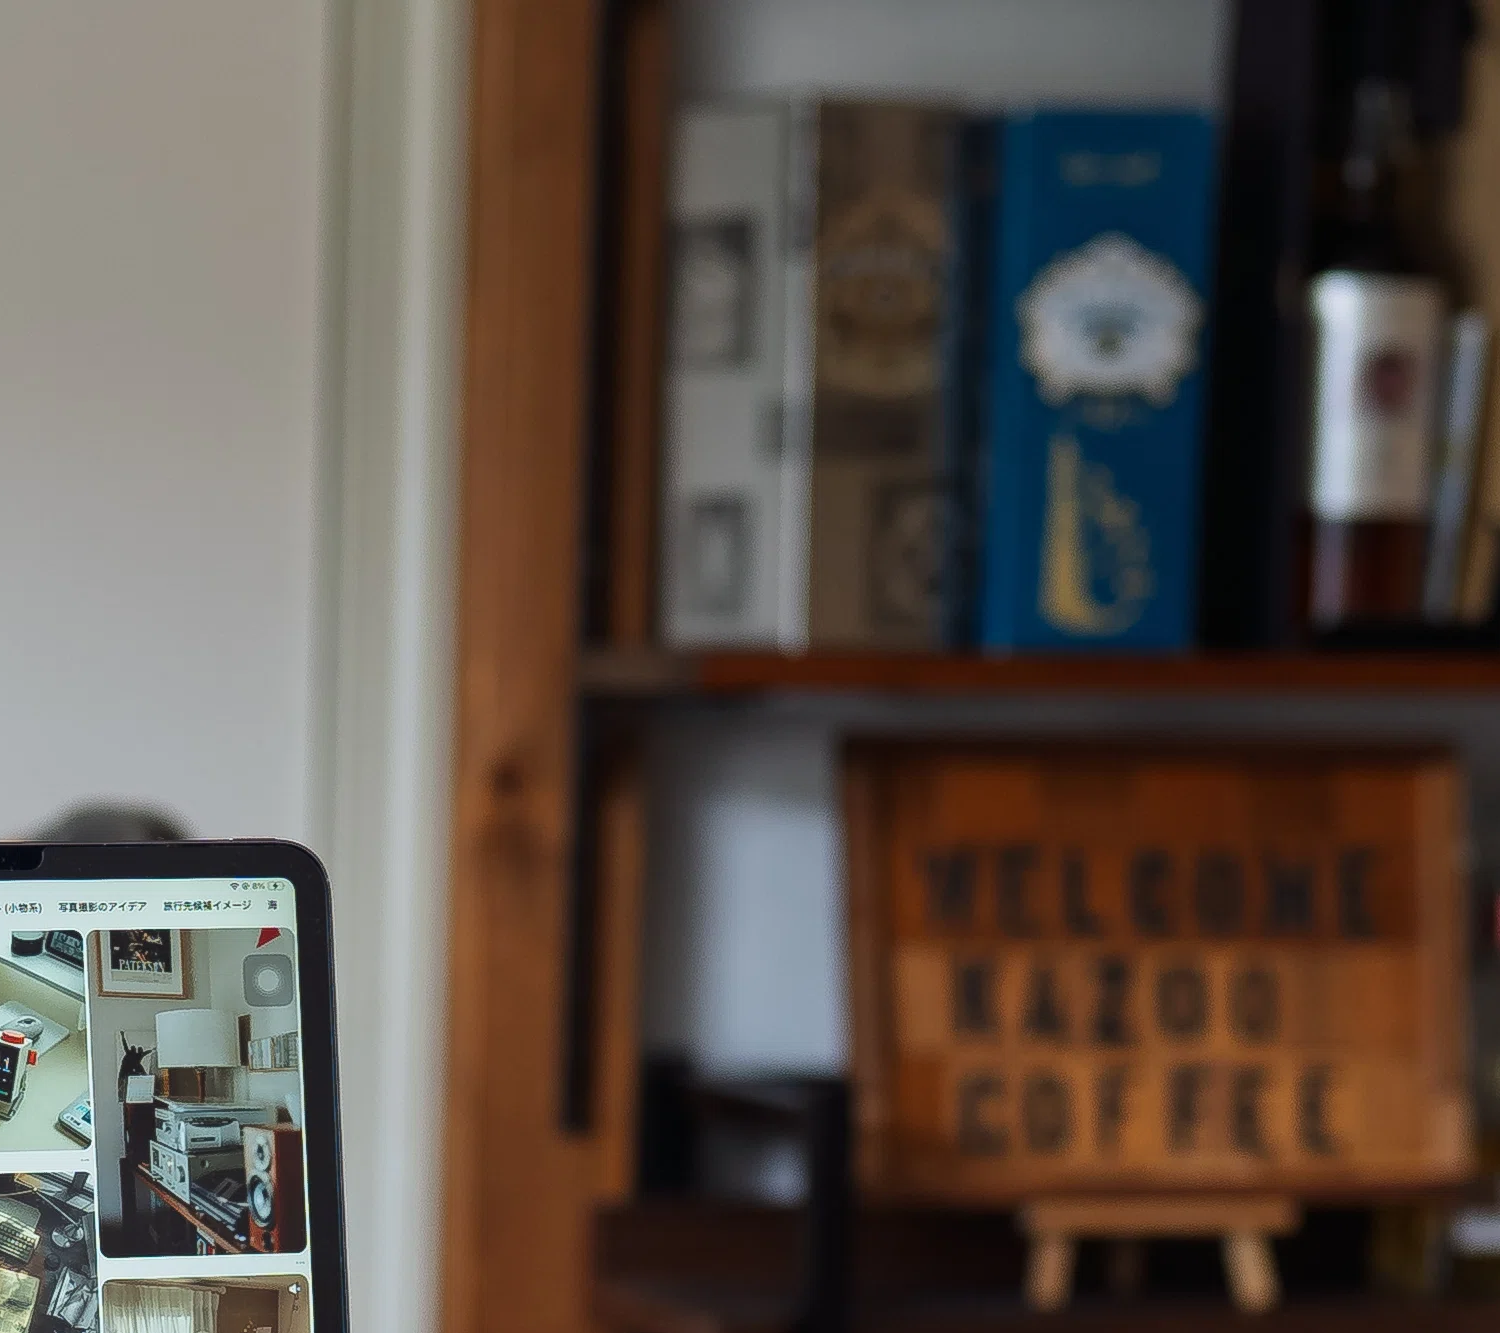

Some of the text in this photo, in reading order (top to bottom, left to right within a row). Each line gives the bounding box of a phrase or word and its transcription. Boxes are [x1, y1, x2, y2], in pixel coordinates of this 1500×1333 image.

[58, 901, 147, 913] 写真撮影のアイデア
[921, 842, 1382, 940] WELCOME
[957, 1062, 1343, 1159] COFFEE
